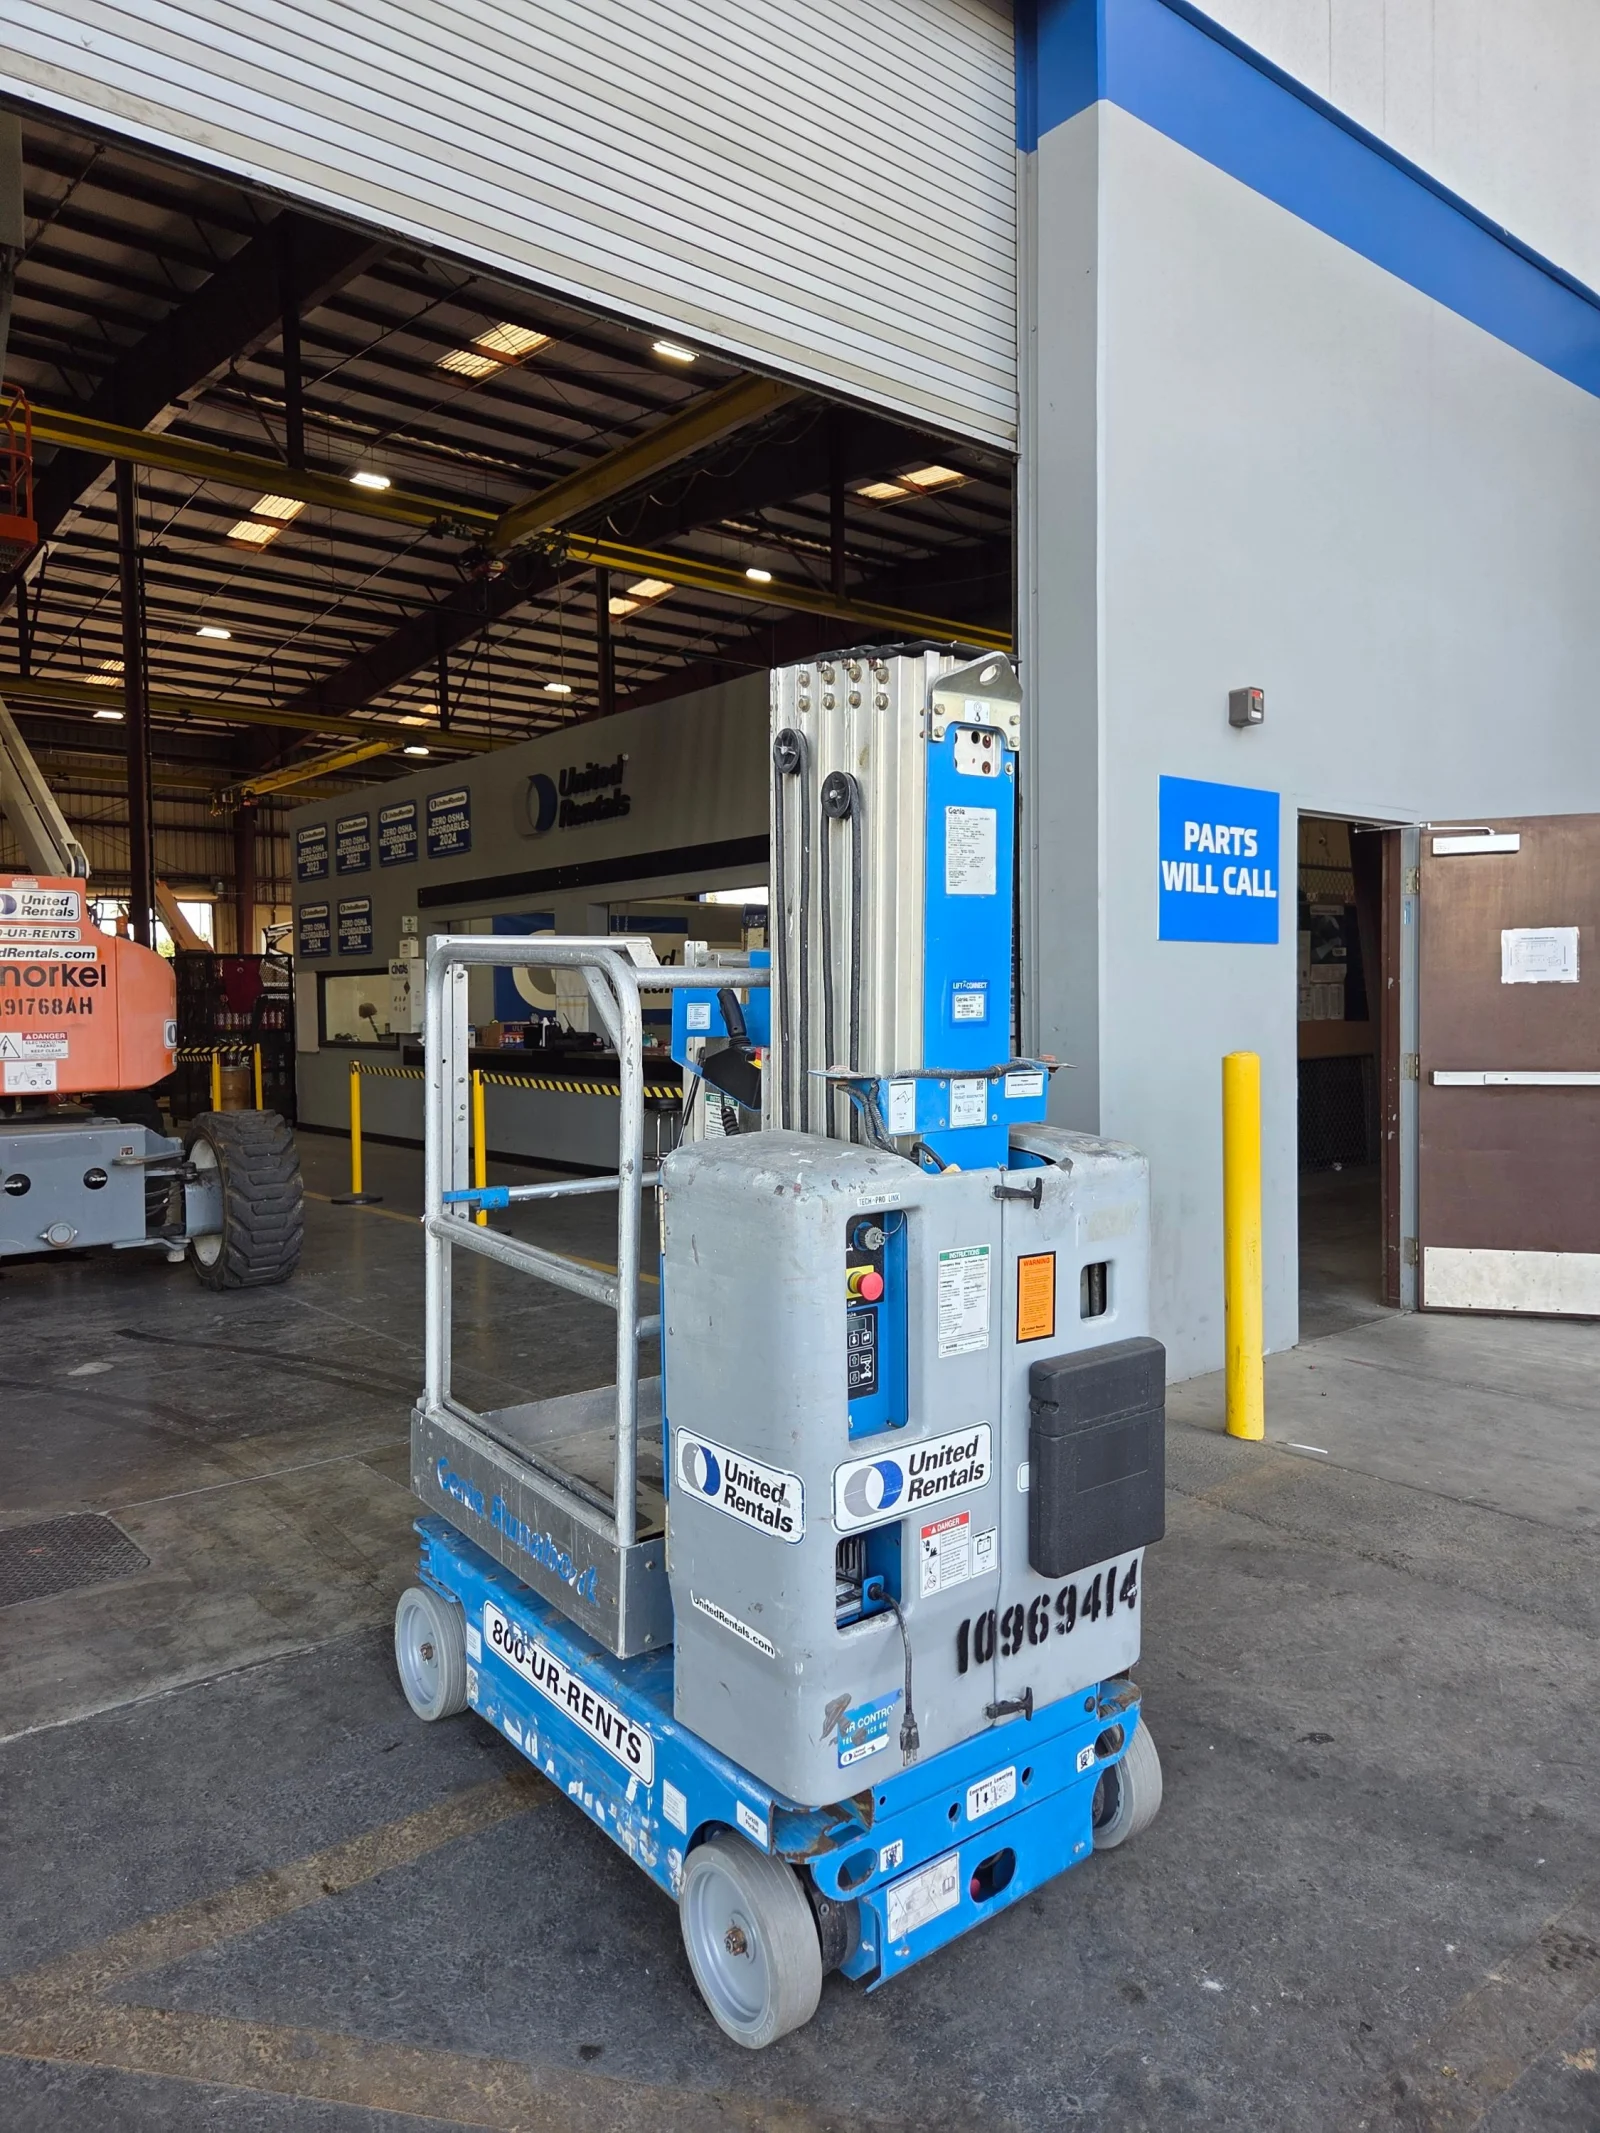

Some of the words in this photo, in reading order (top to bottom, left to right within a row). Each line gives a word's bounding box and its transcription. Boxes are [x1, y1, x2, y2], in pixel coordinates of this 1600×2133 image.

[559, 754, 624, 797] United
[559, 788, 631, 828] Rentals
[948, 807, 966, 816] Genie
[428, 820, 470, 836] RECORDABLES
[431, 816, 446, 827] ZERO
[447, 812, 465, 823] OSHA
[440, 832, 457, 846] 2024
[1184, 821, 1258, 857] PARTS
[1161, 860, 1219, 894] WILL
[1223, 866, 1277, 898] CALL
[21, 895, 70, 906] United
[21, 906, 75, 917] Rentals
[0, 929, 76, 939] -UR-RENTS
[33, 1033, 66, 1041] DANGER
[888, 1194, 900, 1203] LINK
[949, 1249, 980, 1259] INSTRUCTIONS
[1023, 1258, 1050, 1267] WARNING
[908, 1434, 979, 1476] United
[724, 1459, 786, 1504] United
[908, 1460, 984, 1502] Rentals
[724, 1483, 794, 1533] Rentals
[937, 1518, 960, 1532] DANGER
[957, 1558, 1138, 1674] 10969414
[492, 1619, 642, 1764] 800-UR-RENTS
[858, 1704, 895, 1728] CONTRO
[969, 1781, 992, 1796] Emergency
[994, 1771, 1013, 1783] Lowering
